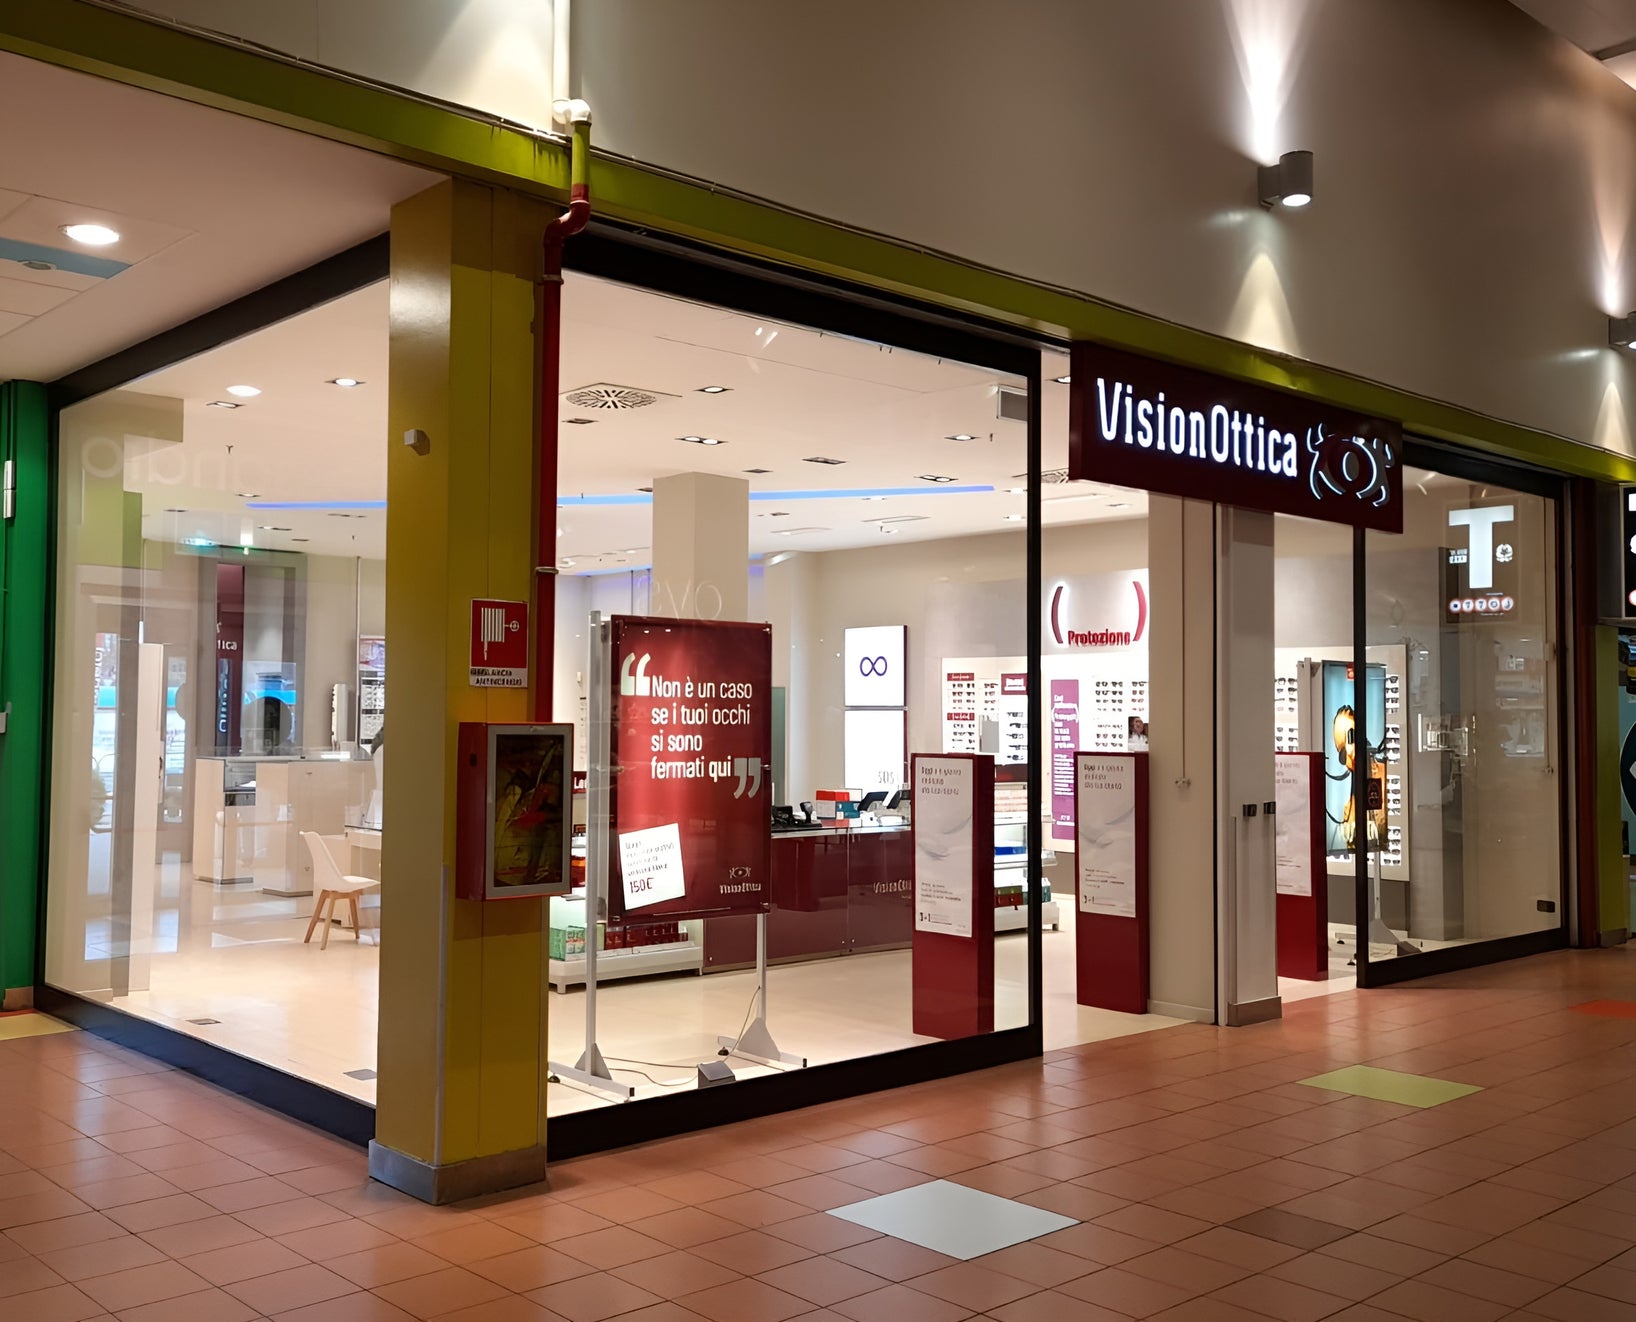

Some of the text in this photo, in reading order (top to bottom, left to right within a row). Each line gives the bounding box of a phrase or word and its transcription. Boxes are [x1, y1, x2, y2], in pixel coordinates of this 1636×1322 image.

[1096, 377, 1298, 478] VisionOttica
[652, 675, 753, 699] Non è un caso
[651, 702, 750, 725] se i tuoi occhi
[651, 729, 703, 752] si sono
[651, 755, 731, 783] fermati qui
